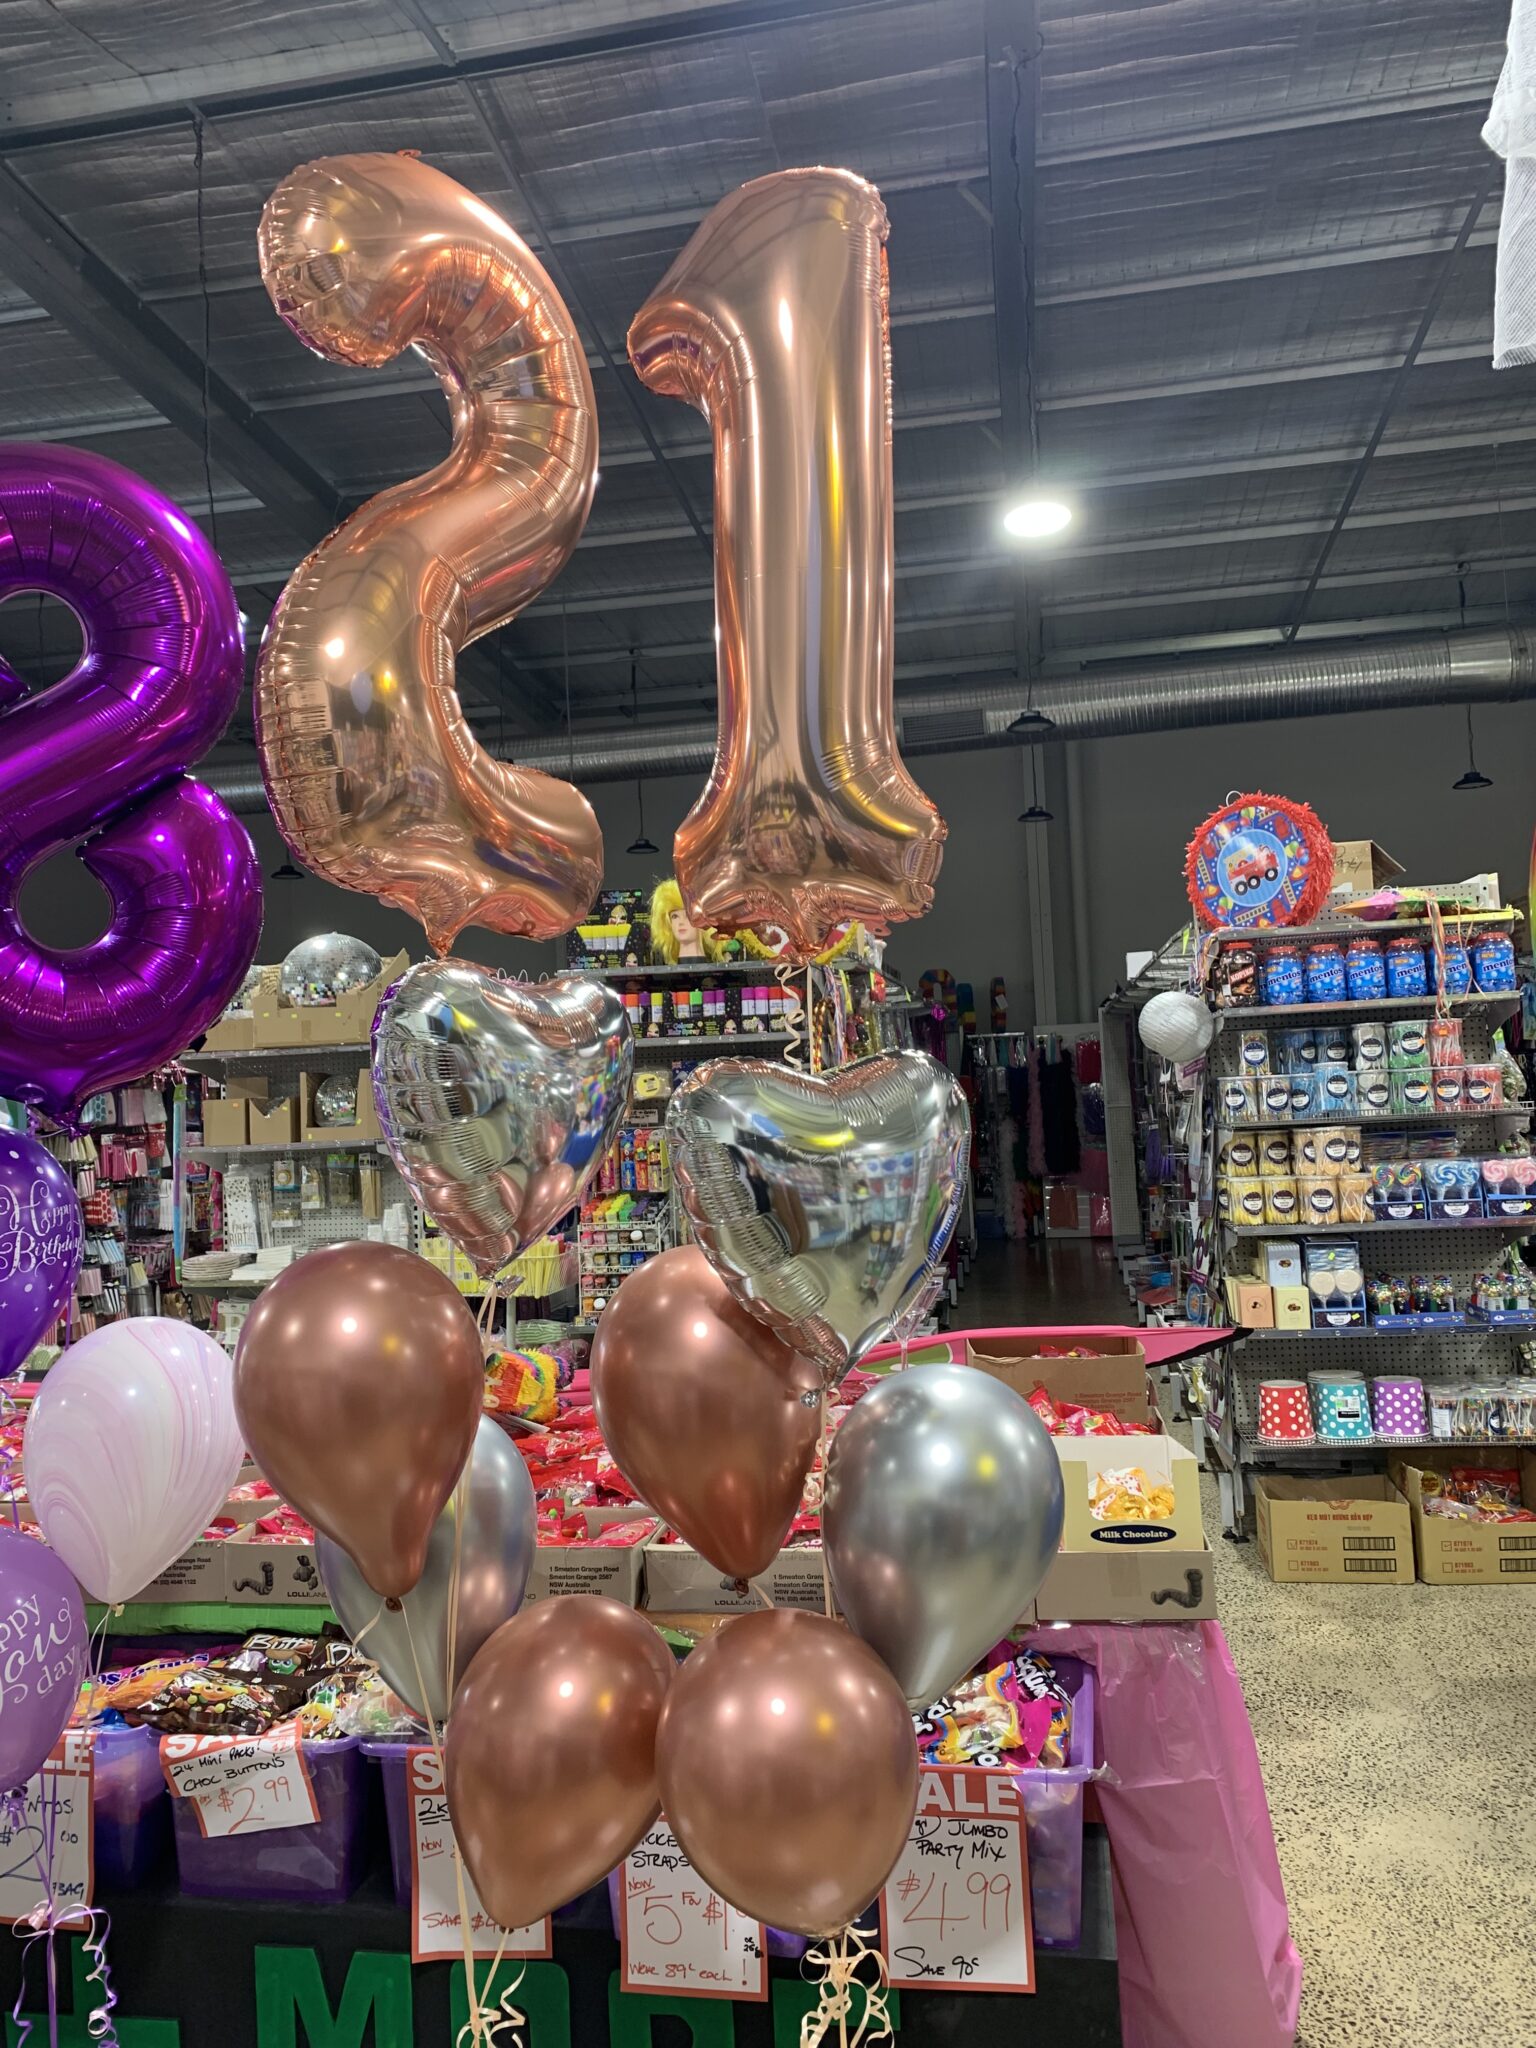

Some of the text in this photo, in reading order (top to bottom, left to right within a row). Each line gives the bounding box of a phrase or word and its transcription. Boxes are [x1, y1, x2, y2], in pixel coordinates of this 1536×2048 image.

[1309, 966, 1343, 983] mentos
[1350, 965, 1384, 980] mentos
[1396, 965, 1425, 978] ment
[1450, 962, 1468, 973] men
[1483, 959, 1514, 972] mento
[1268, 970, 1301, 986] mentos
[0, 1180, 80, 1236] Happy
[0, 1227, 84, 1282] Birthday
[1123, 1530, 1168, 1538] Chocolate
[0, 1594, 40, 1653] ppy
[37, 1645, 76, 1696] day
[165, 1722, 297, 1758] SAE
[172, 1764, 194, 1777] 24
[183, 1775, 221, 1792] CHOC
[919, 1772, 1020, 1816] ALE
[217, 1776, 292, 1834] $2.99
[947, 1819, 1008, 1839] JUMBO
[916, 1839, 964, 1869] PARTY
[896, 1869, 1011, 1941] $4.99
[643, 1894, 683, 1945] 5
[699, 1969, 733, 1981] each
